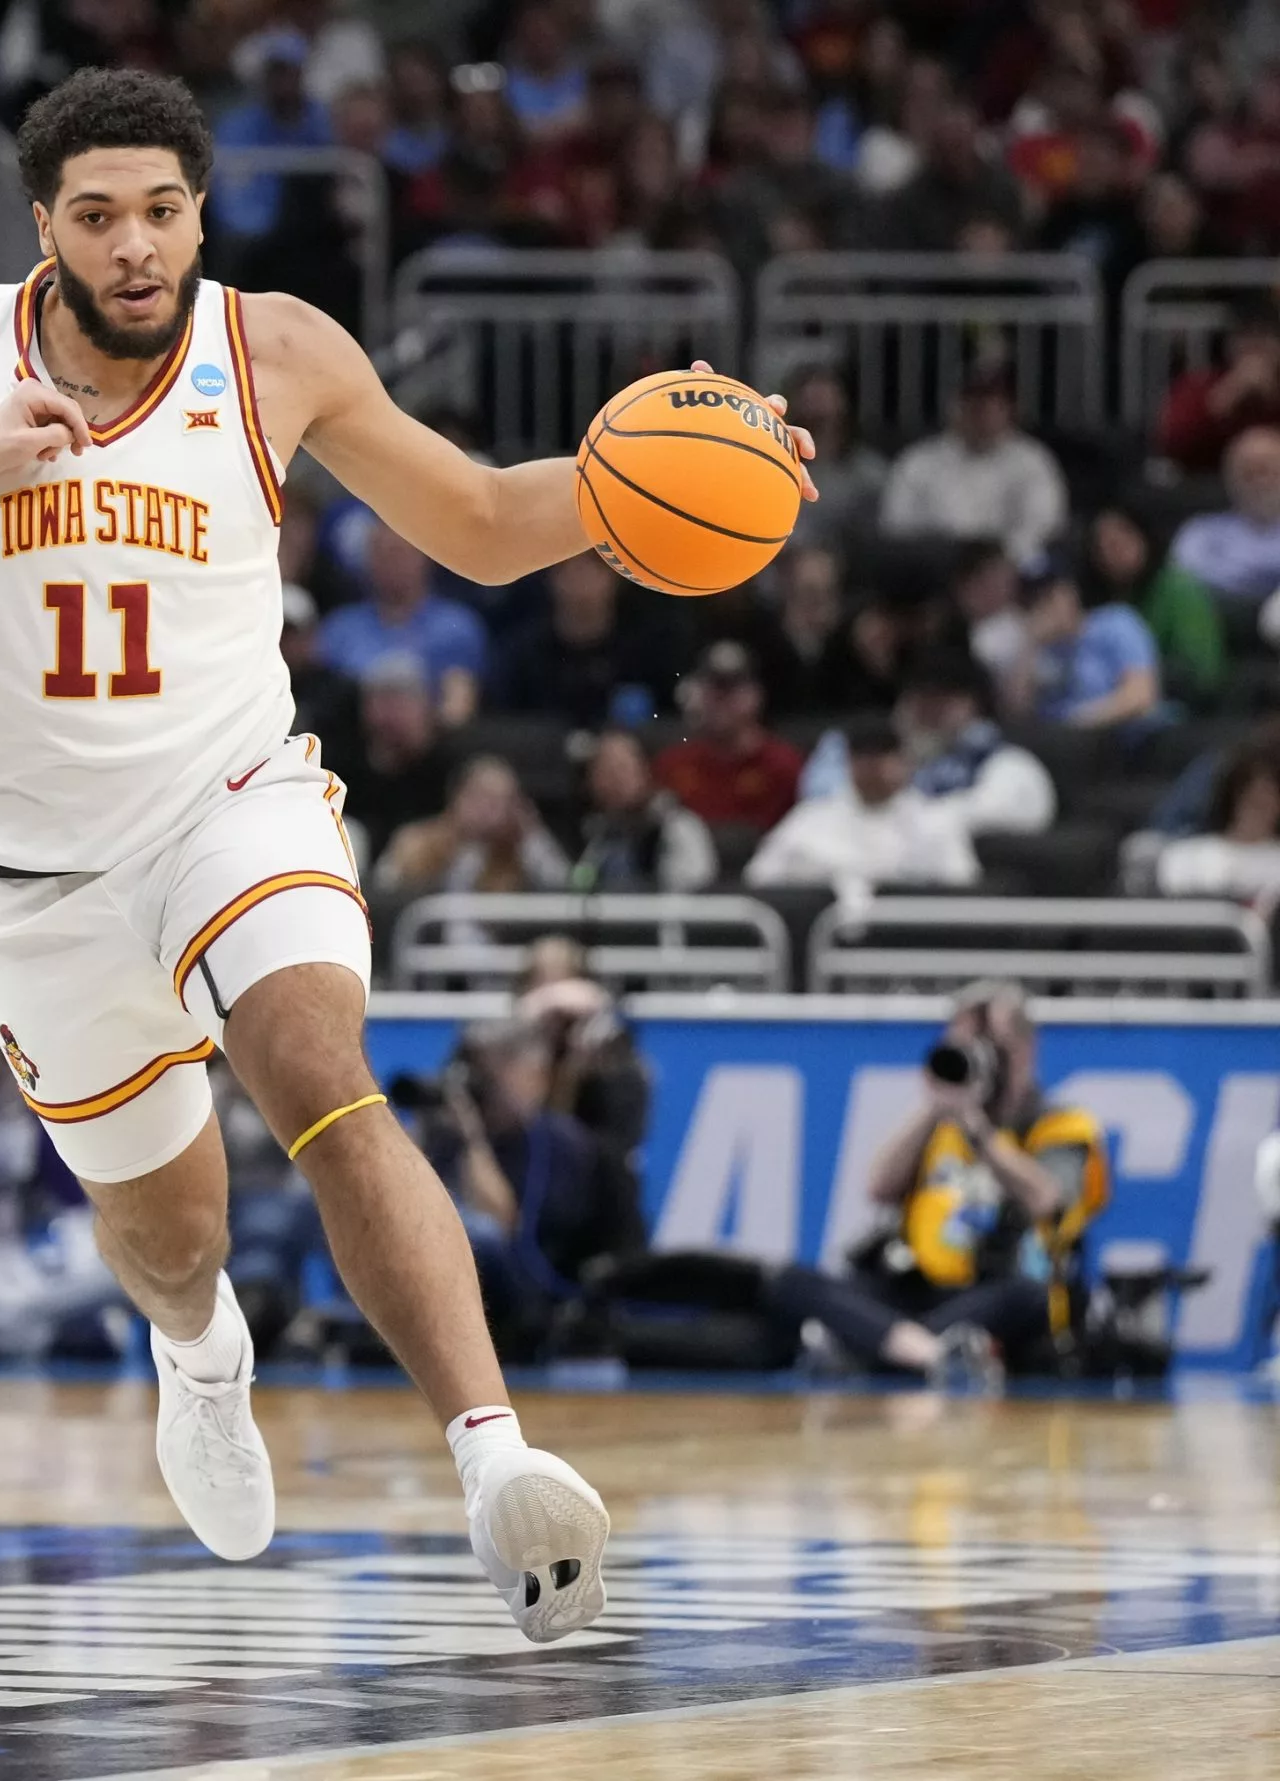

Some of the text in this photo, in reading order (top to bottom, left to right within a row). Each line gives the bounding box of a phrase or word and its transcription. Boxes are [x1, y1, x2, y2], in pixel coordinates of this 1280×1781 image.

[668, 390, 797, 464] Wilson
[0, 479, 210, 566] IOWA STATE
[43, 579, 163, 699] 11
